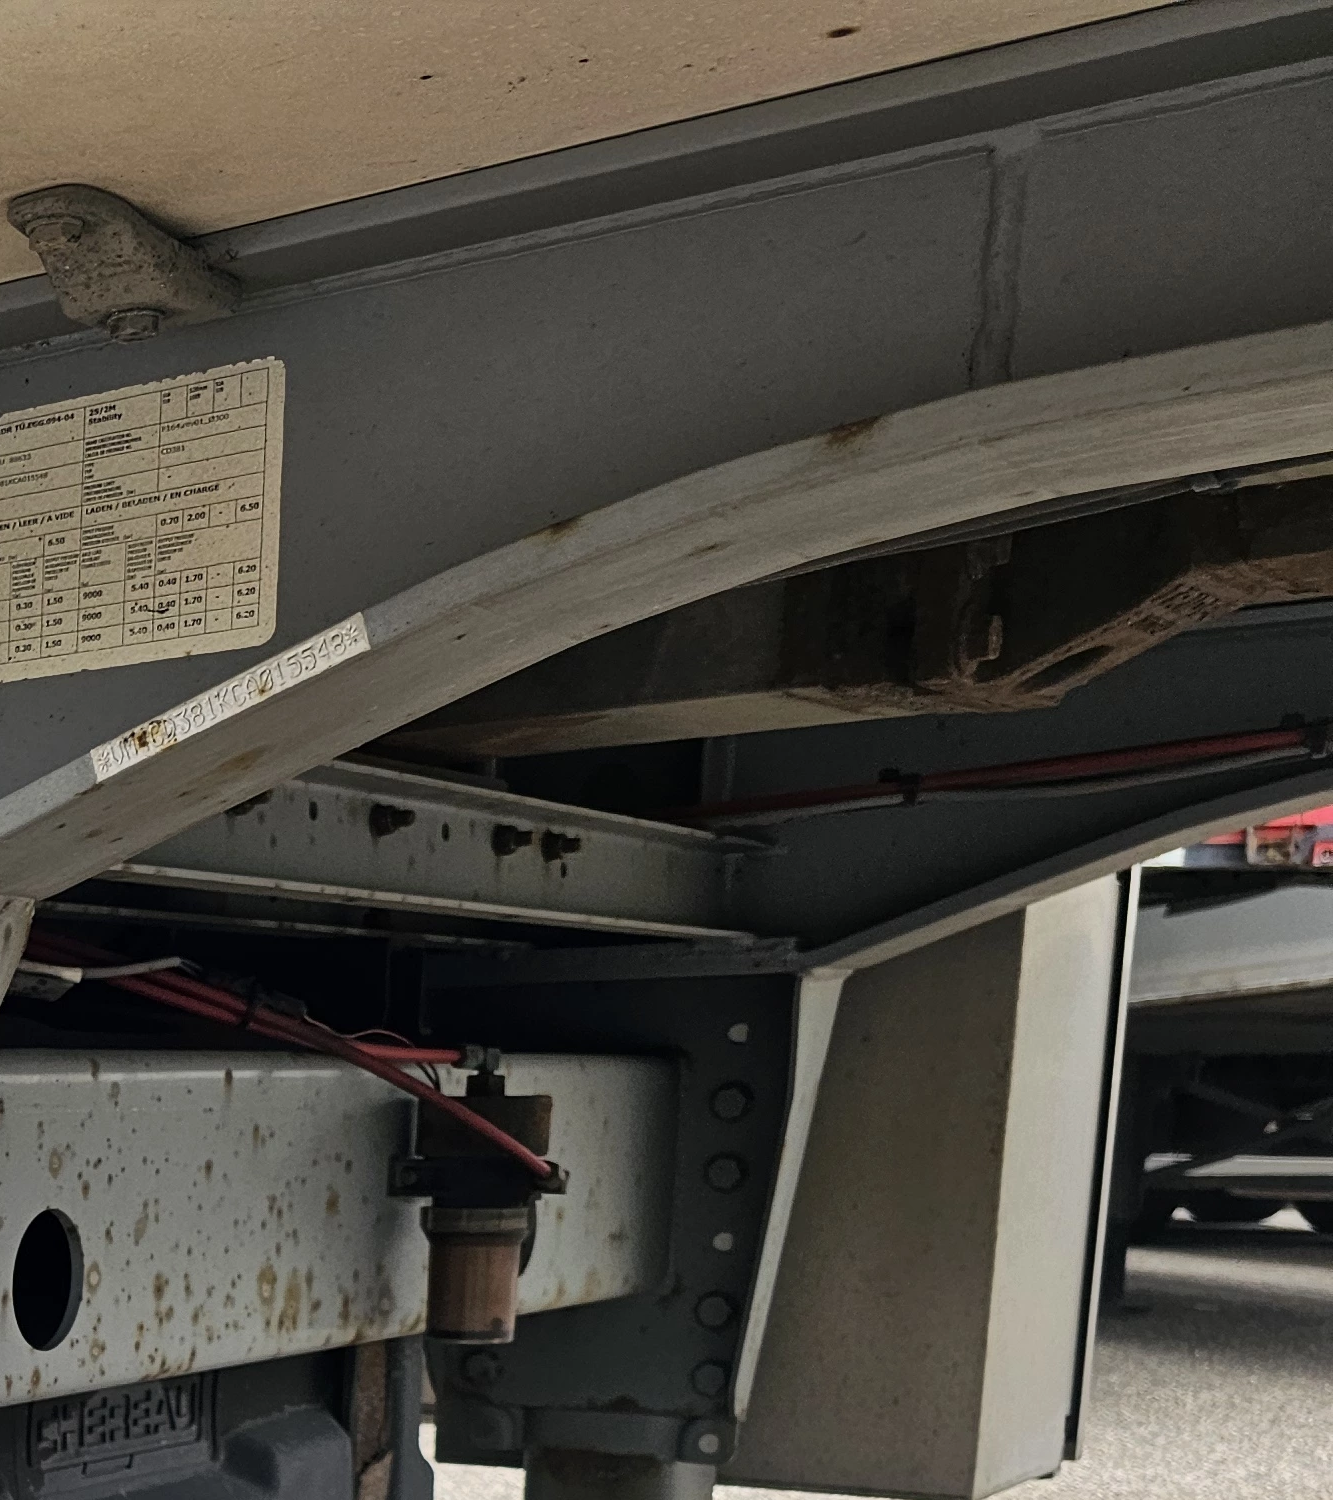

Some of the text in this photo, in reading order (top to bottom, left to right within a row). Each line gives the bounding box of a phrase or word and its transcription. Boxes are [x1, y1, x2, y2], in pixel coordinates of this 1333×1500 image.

[88, 413, 123, 425] Stability
[85, 504, 113, 515] LADEN
[121, 496, 161, 509] BELADEN
[169, 491, 182, 499] EN
[183, 484, 220, 496] CHARGE
[160, 502, 260, 526] 0.70 2.00 6.50
[18, 517, 39, 527] LEER
[54, 511, 75, 520] VIDE
[47, 537, 65, 546] 6.50
[46, 596, 64, 606] 1.50
[185, 573, 203, 583] 1.70
[237, 564, 257, 574] 6.20
[45, 618, 63, 627] 1.50
[184, 596, 203, 606] 1.70
[236, 587, 256, 597] 6.20
[45, 640, 62, 648] 1.50
[183, 618, 202, 628] 1.70
[235, 610, 255, 619] 6.20
[37, 1382, 196, 1459] CHEREAU
